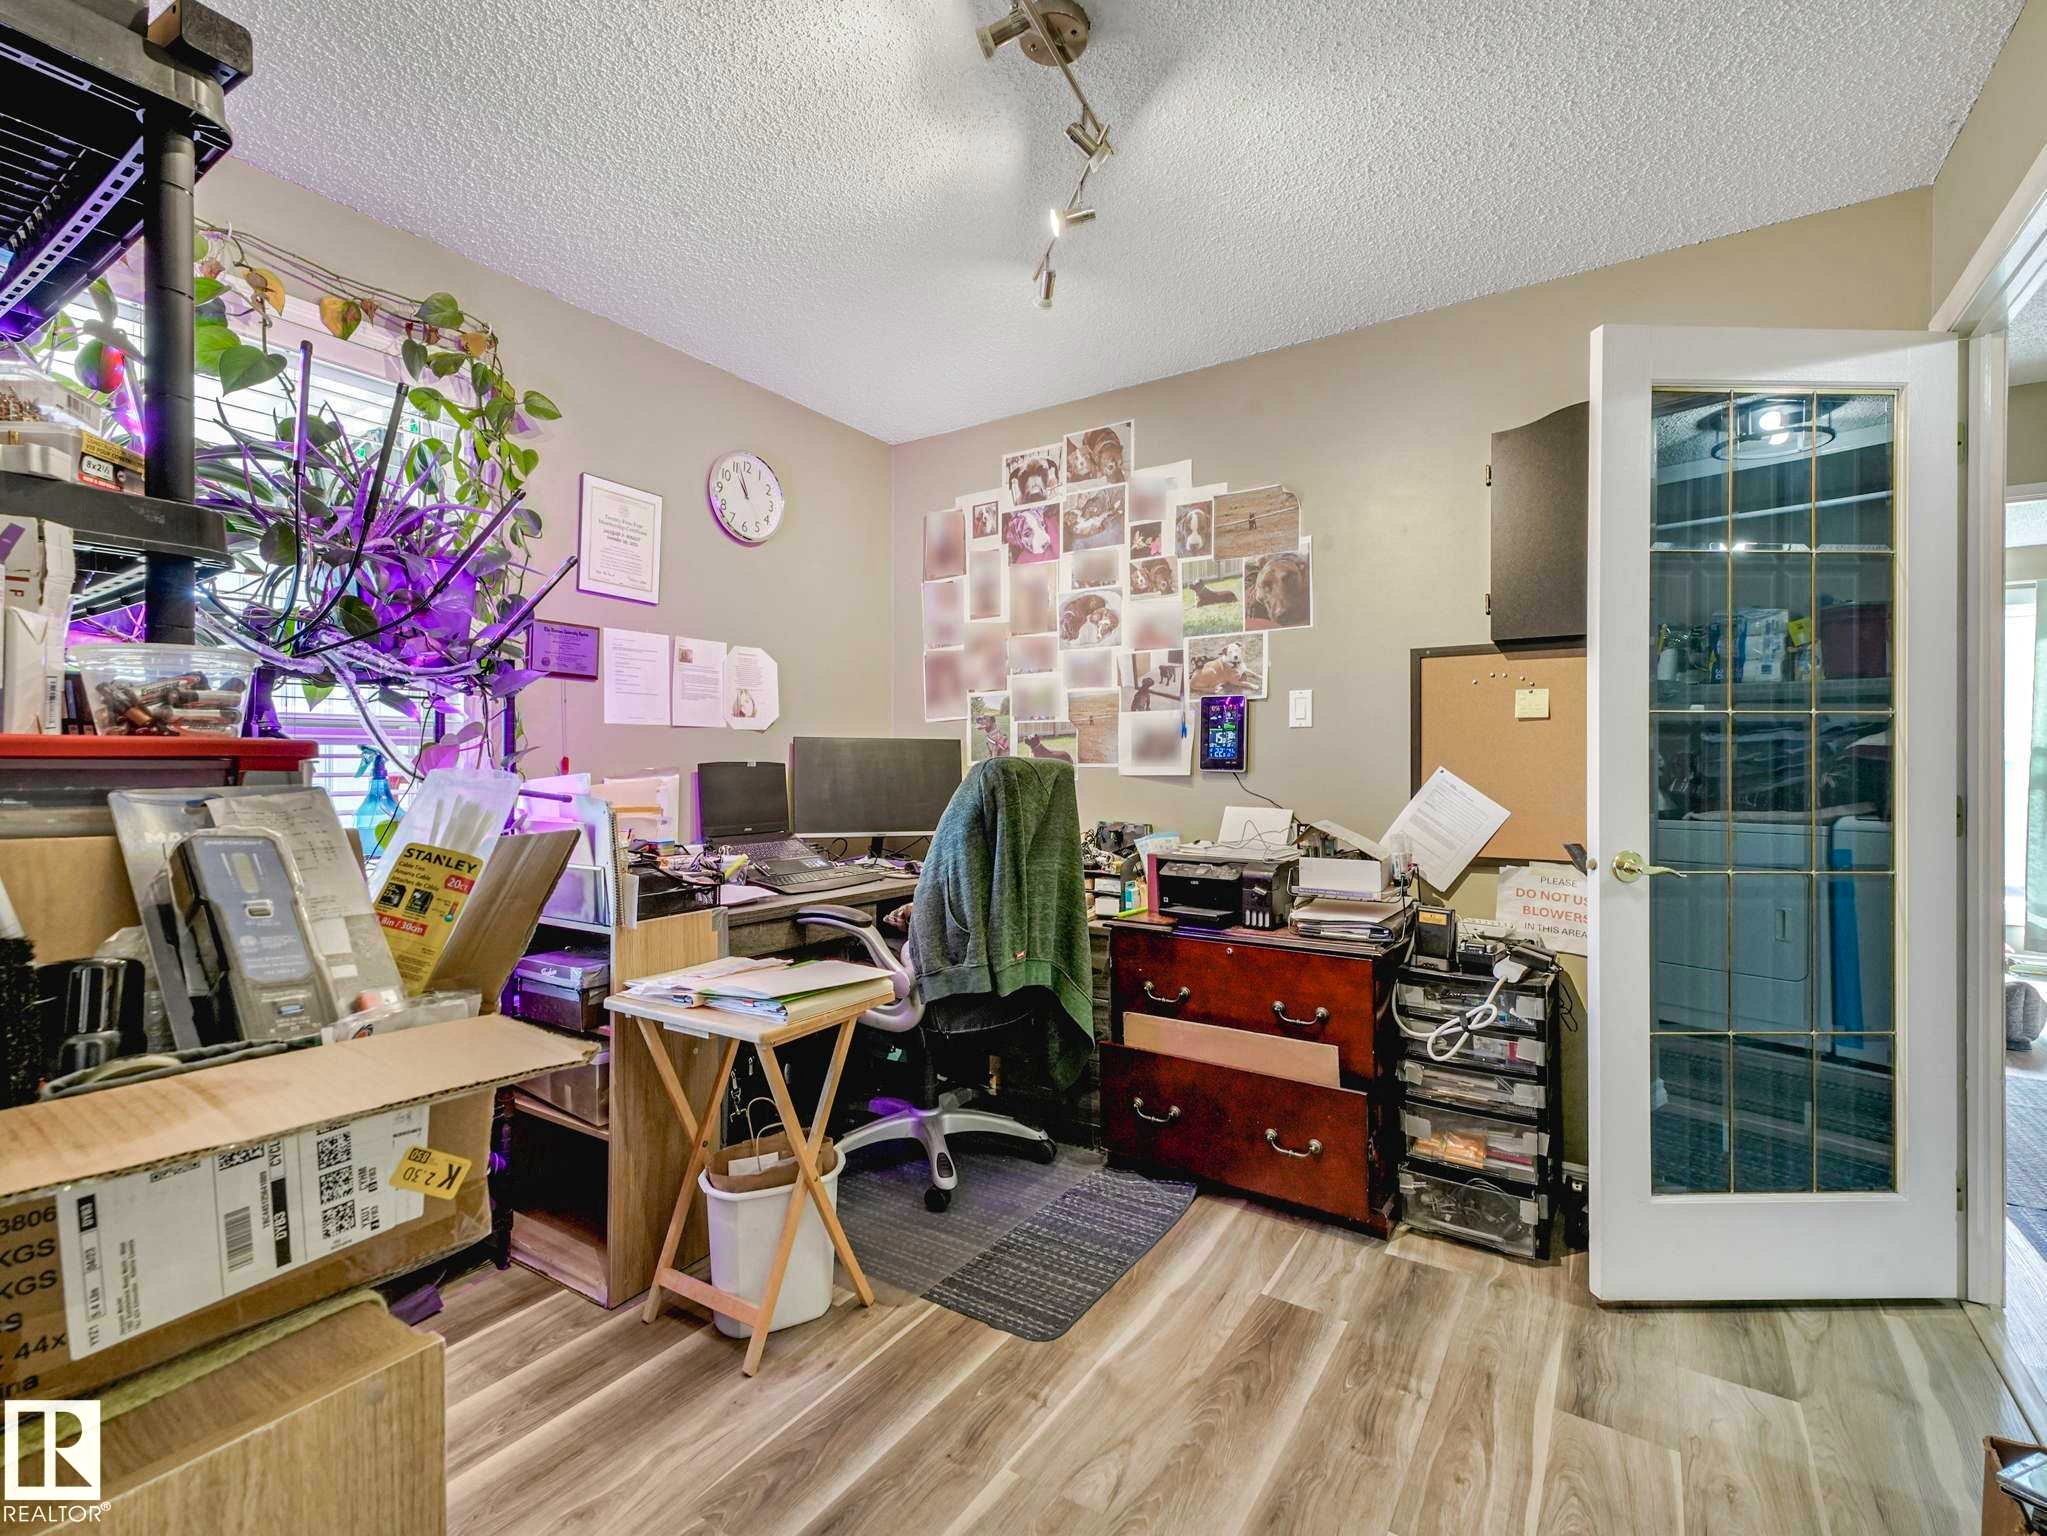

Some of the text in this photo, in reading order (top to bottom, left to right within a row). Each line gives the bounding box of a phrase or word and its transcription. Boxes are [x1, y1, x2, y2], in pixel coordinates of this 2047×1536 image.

[733, 461, 739, 474] 11
[743, 461, 752, 474] 12
[721, 468, 731, 481] 10
[716, 481, 723, 493] 9
[766, 484, 771, 496] 2
[720, 498, 727, 511] 8
[768, 500, 774, 512] 3
[729, 512, 736, 523] 7
[763, 515, 769, 525] 4
[741, 521, 748, 532] 6
[754, 521, 760, 533] 5
[403, 848, 477, 873] STANLEY
[1540, 876, 1577, 888] PLEASE
[1515, 888, 1588, 906] DO NOT US
[1522, 905, 1588, 924] BLOWERS
[1524, 922, 1588, 938] IN THIS AREA
[437, 1163, 462, 1190] K
